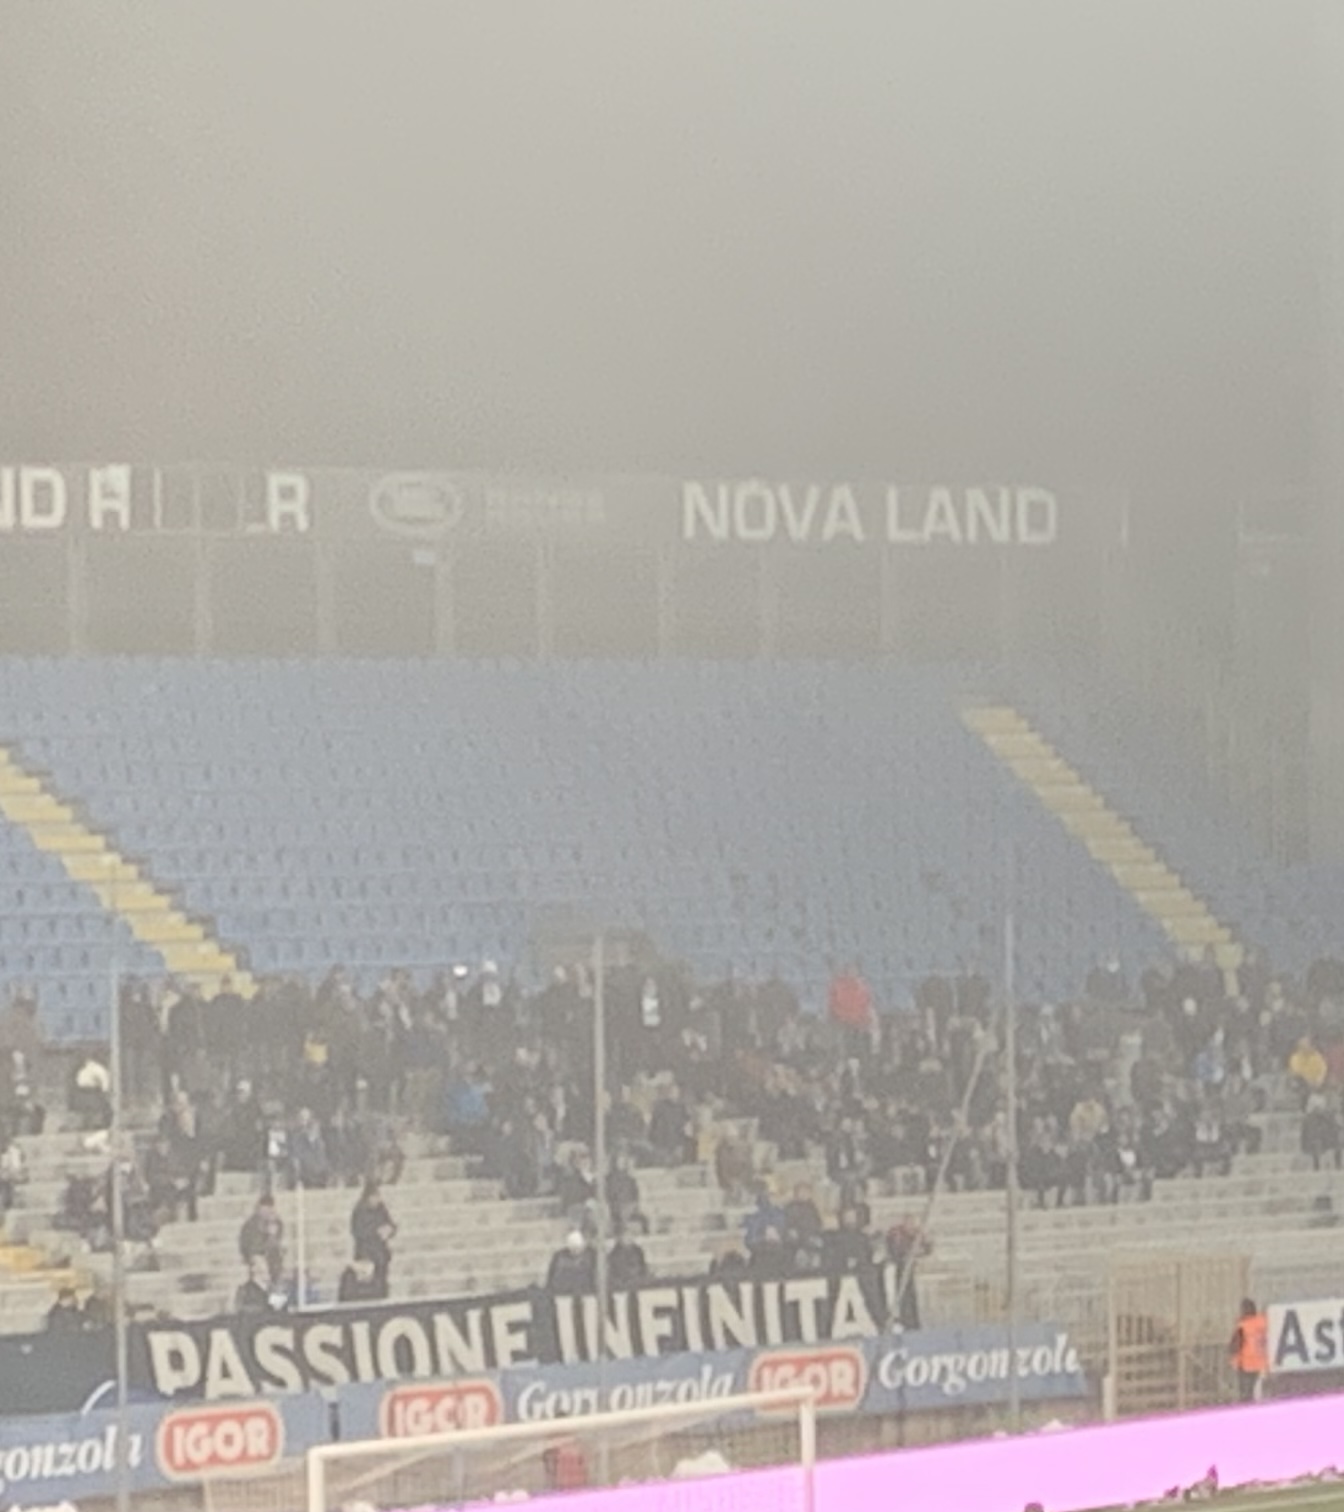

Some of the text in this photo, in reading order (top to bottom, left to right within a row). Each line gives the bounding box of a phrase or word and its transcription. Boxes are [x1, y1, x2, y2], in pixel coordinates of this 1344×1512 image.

[680, 478, 1057, 545] NOVA LAND
[149, 1302, 533, 1400] PASSIONE
[172, 1416, 270, 1468] IGOR
